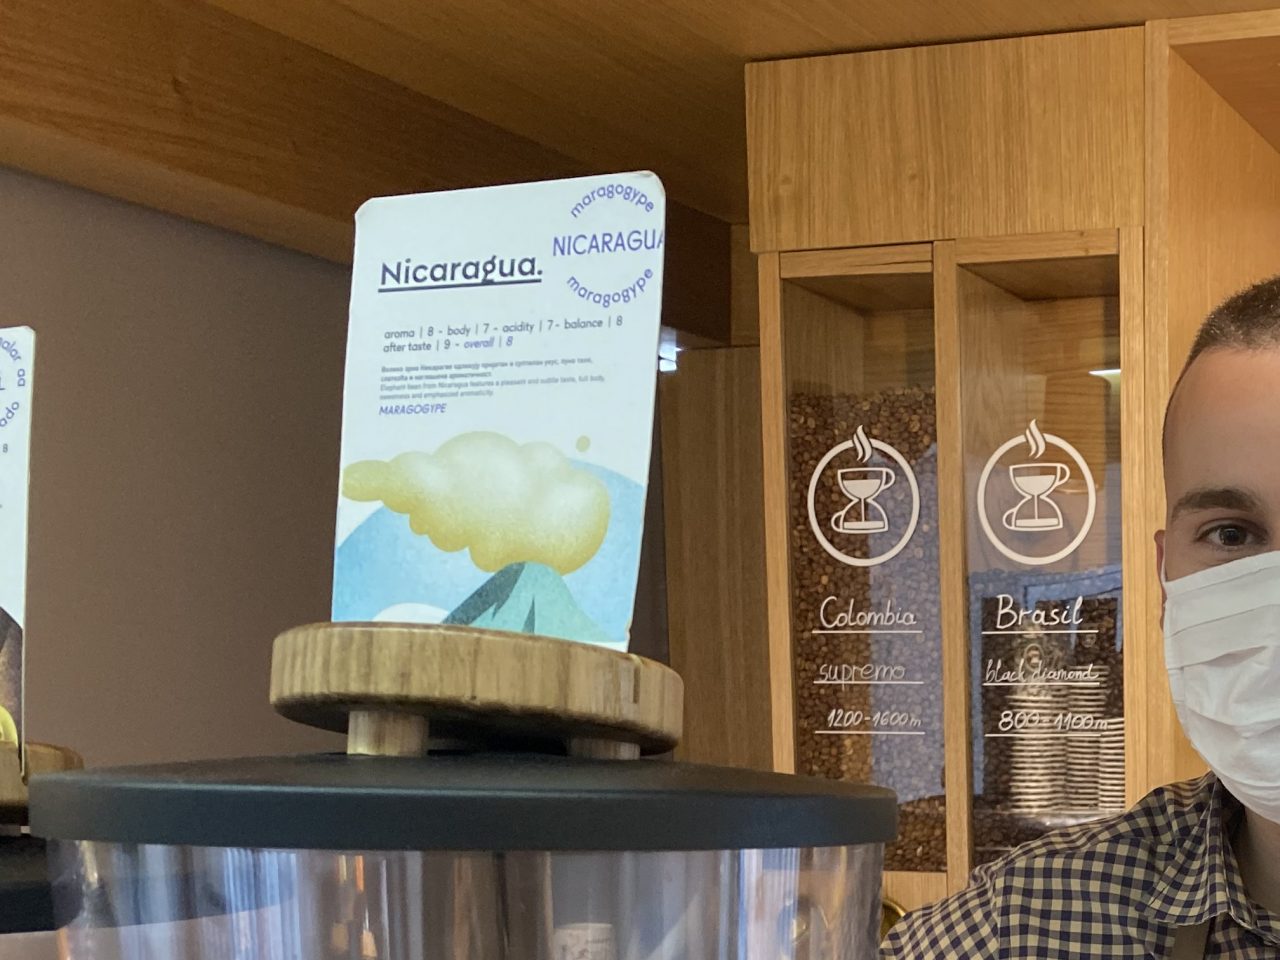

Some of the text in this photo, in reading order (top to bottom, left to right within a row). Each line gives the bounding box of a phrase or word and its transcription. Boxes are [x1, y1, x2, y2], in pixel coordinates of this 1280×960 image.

[570, 184, 655, 218] maragogype
[381, 255, 543, 286] Nicaragua.
[566, 268, 654, 308] maragogype
[384, 329, 415, 339] aroma
[447, 324, 471, 336] body
[502, 321, 535, 334] acidity
[564, 318, 603, 329] balance
[383, 342, 405, 353] after
[408, 342, 432, 351] taste
[464, 336, 495, 348] overall
[379, 403, 447, 416] MARAGOGYPE
[819, 595, 918, 629] Colombia
[994, 593, 1084, 629] Brasil
[818, 663, 906, 691] supremo
